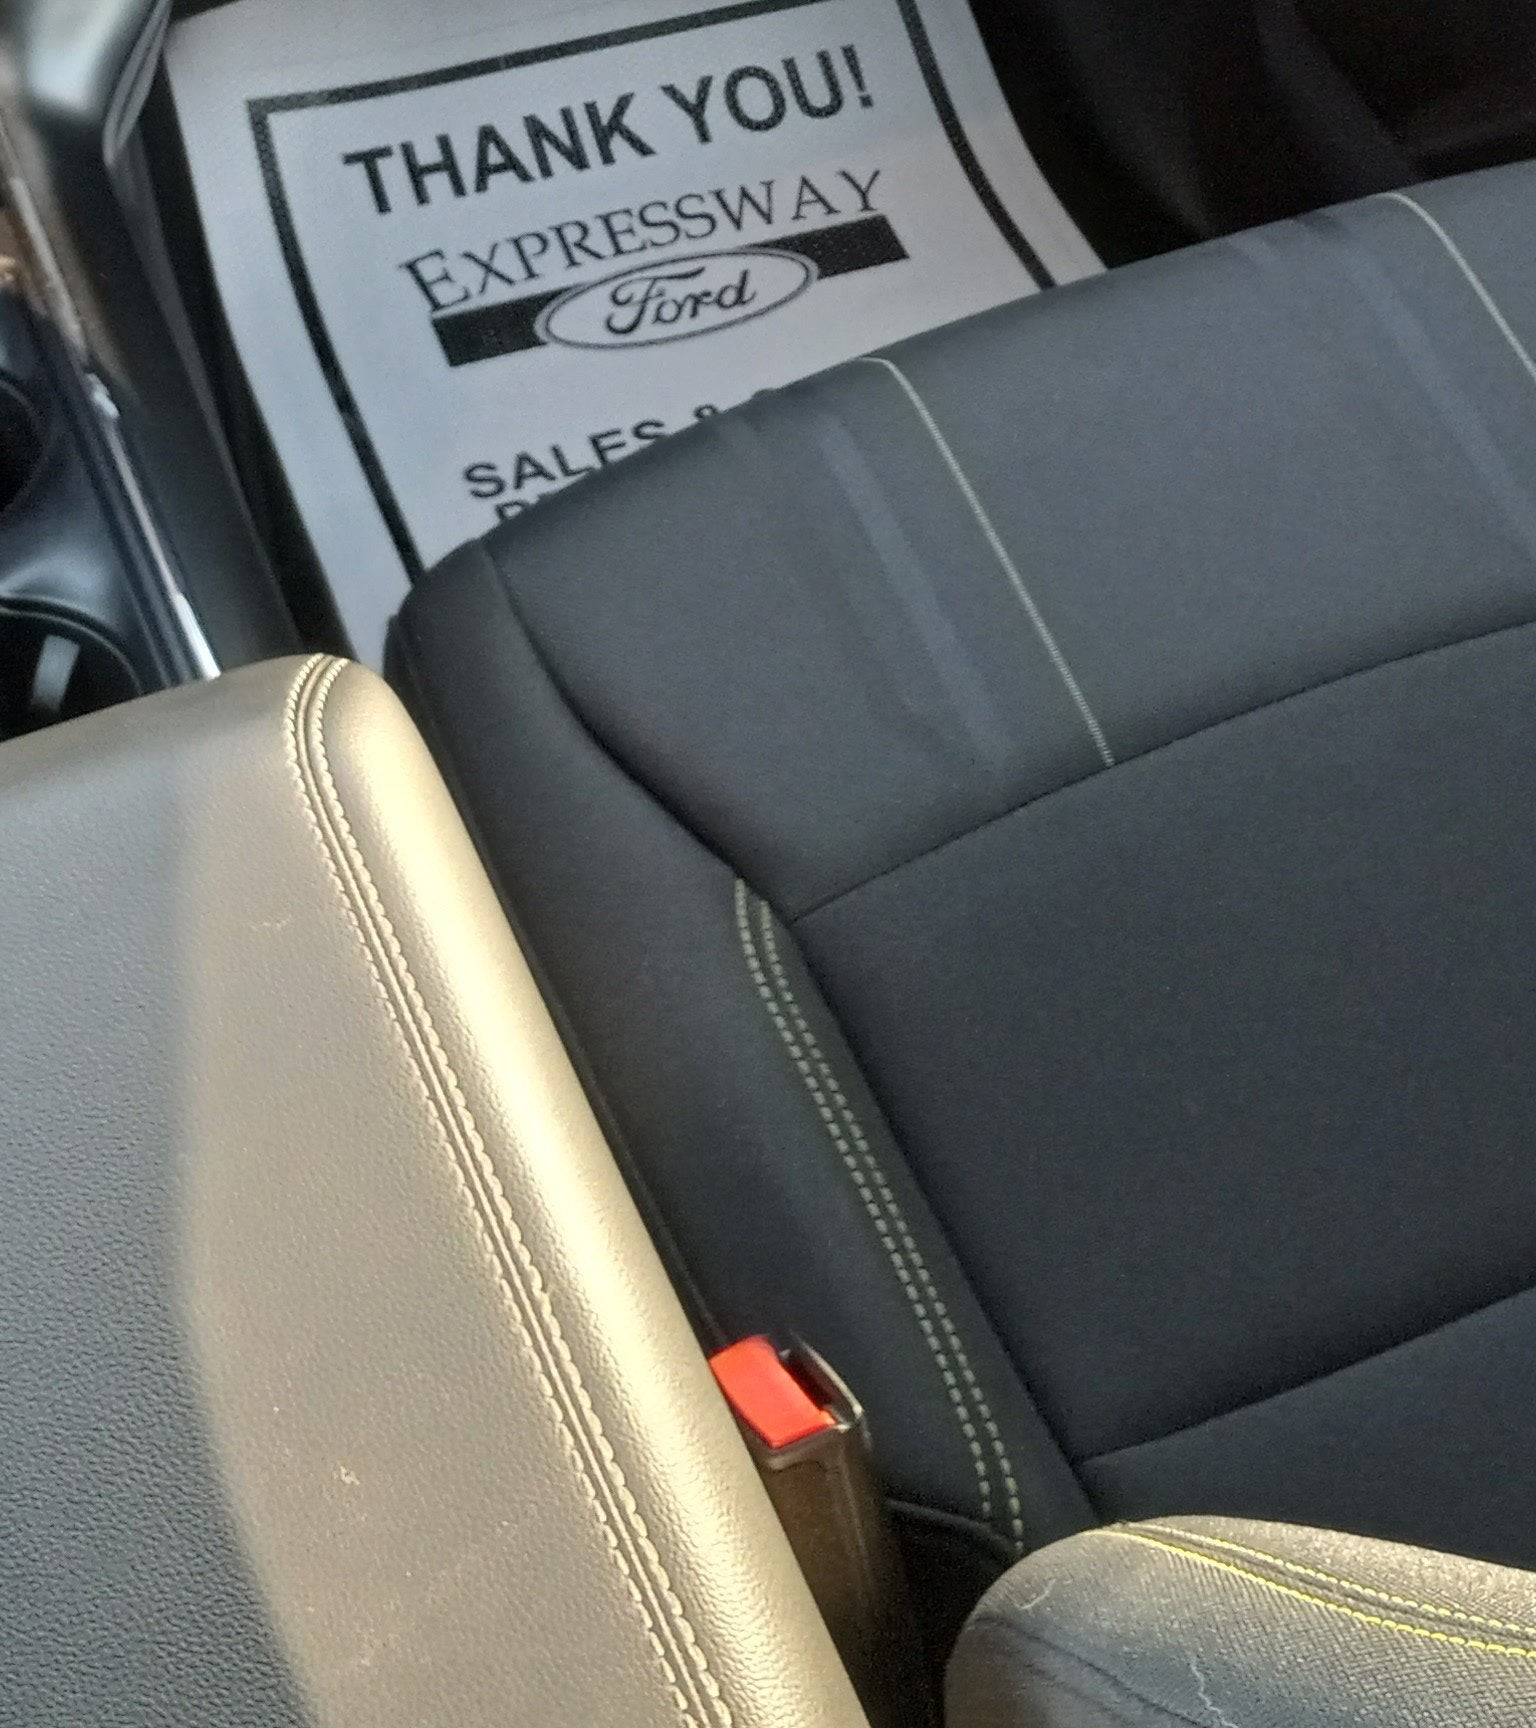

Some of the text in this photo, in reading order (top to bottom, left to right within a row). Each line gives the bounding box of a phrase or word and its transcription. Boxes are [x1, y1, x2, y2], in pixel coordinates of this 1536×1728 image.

[343, 44, 876, 217] THANK YOU!
[398, 169, 884, 314] EXPRESSWAY
[603, 267, 761, 338] Ford
